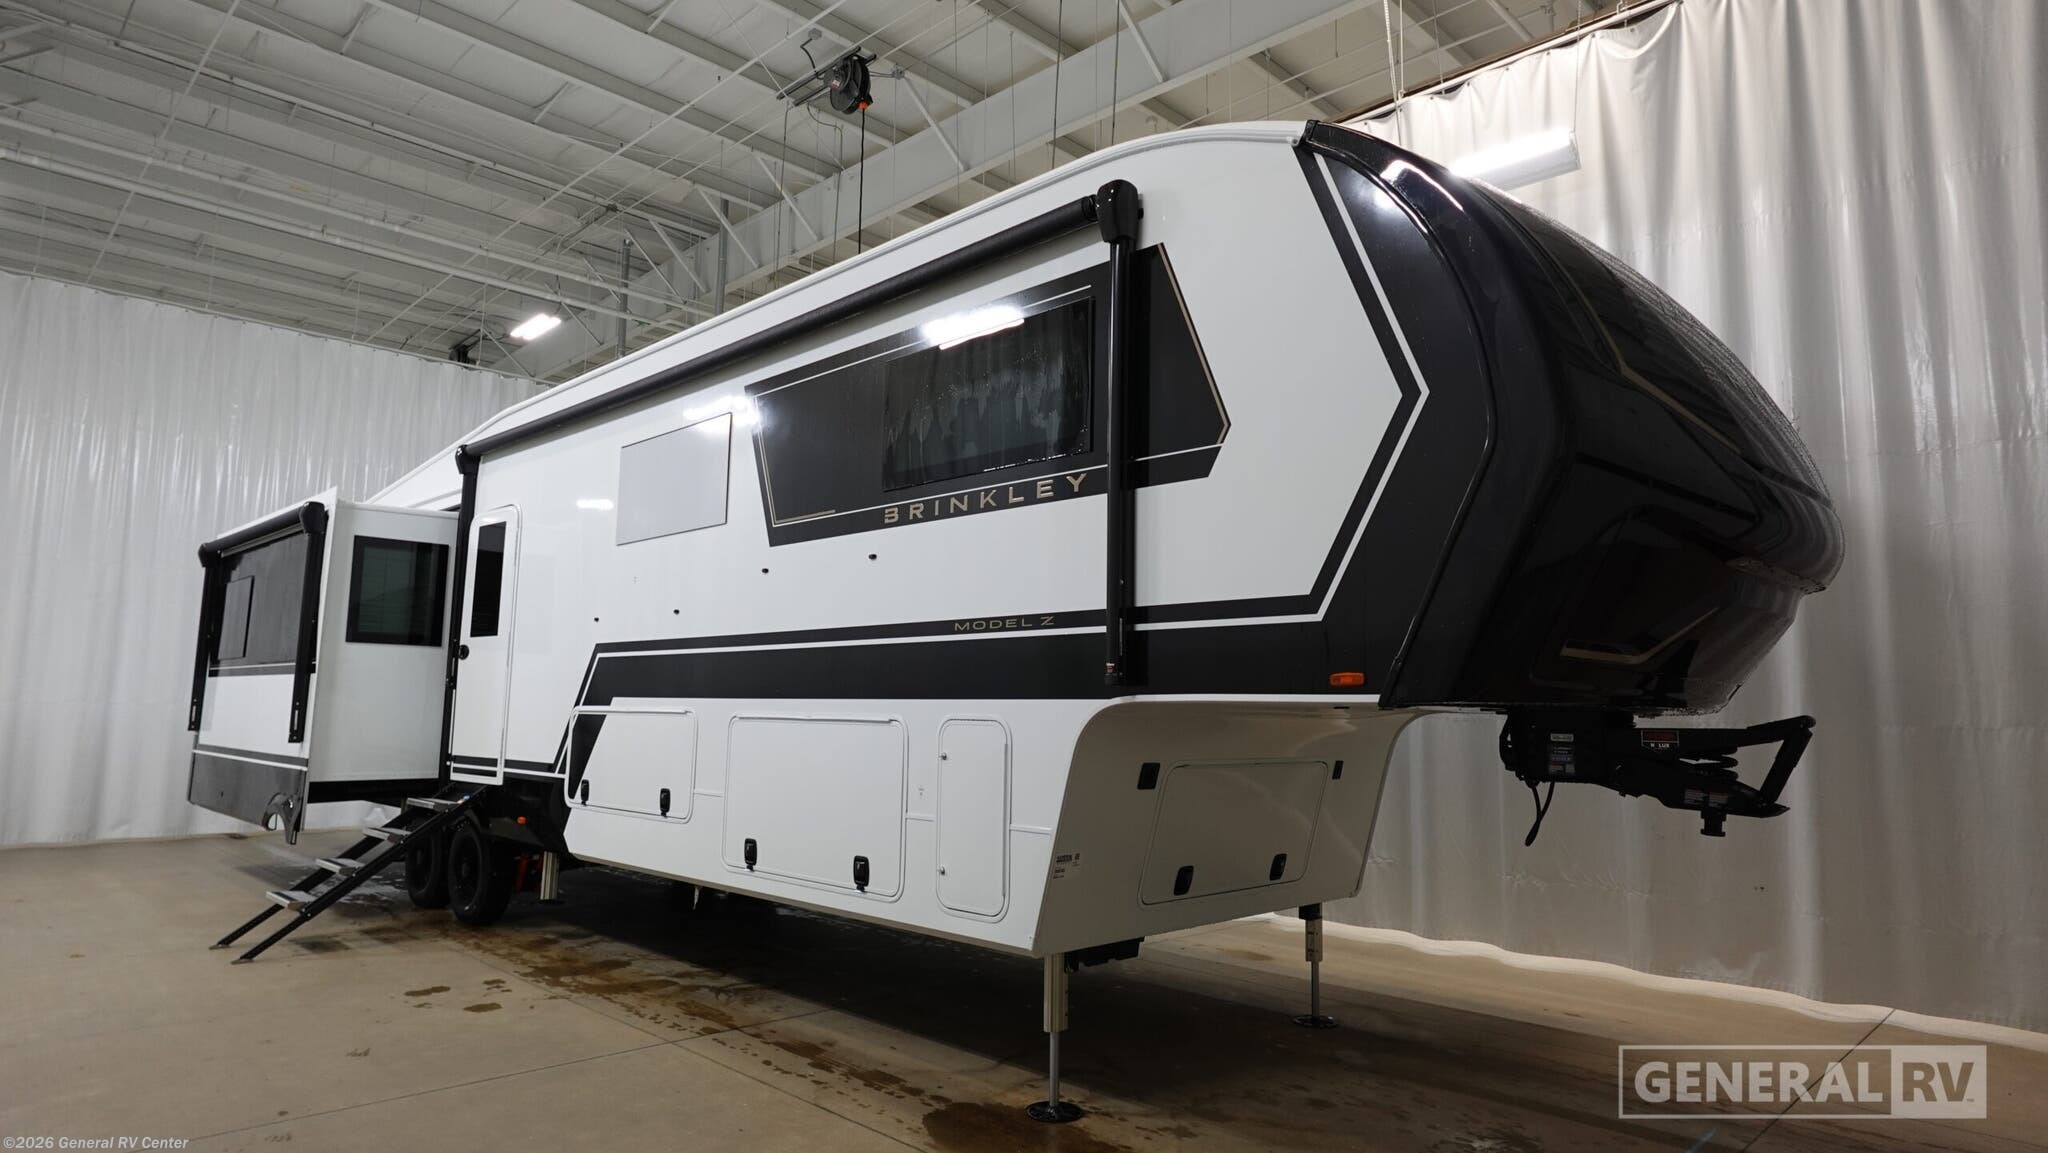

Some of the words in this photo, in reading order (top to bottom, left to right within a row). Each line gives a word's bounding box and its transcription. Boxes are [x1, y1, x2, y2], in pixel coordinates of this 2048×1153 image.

[884, 473, 1087, 524] BRINKLEY
[954, 618, 1033, 632] MODEL
[1040, 616, 1055, 627] Z
